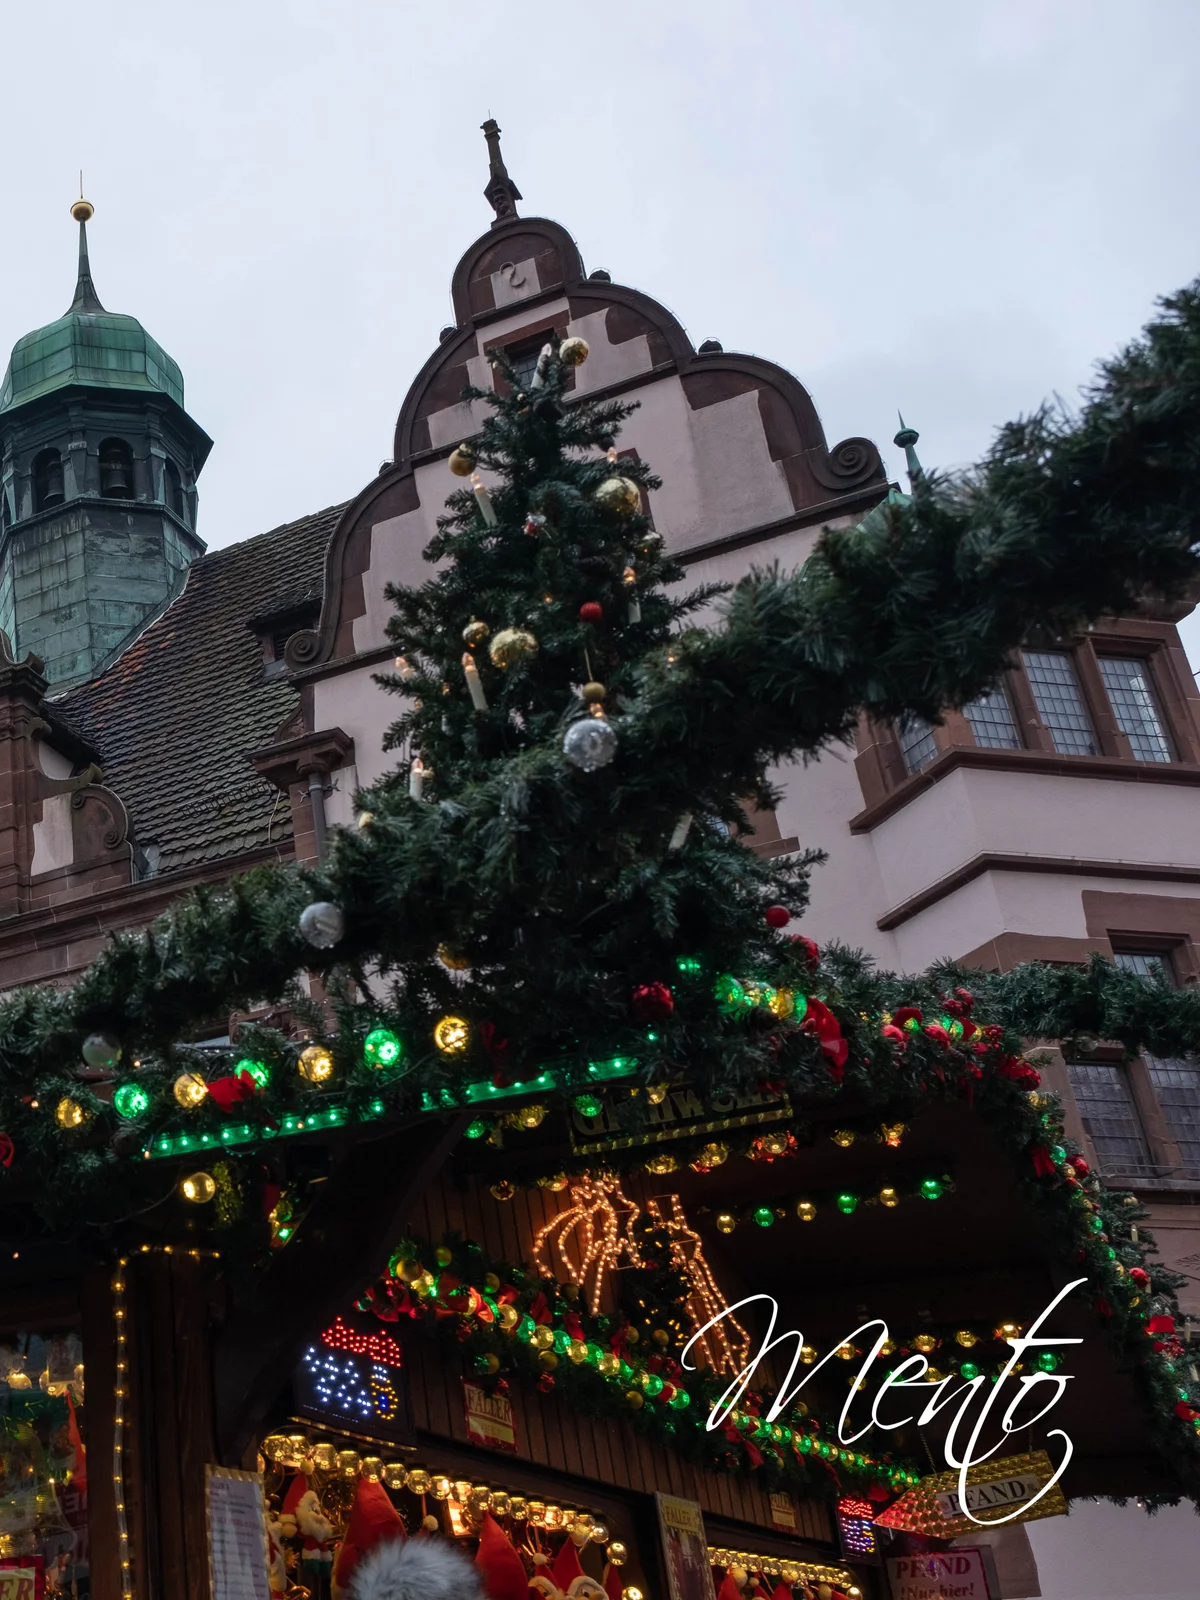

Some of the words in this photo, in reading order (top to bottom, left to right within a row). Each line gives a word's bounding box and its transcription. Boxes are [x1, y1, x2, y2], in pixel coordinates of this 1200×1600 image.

[946, 1480, 1026, 1511] PFAND
[896, 1556, 972, 1580] PFAND
[939, 1582, 975, 1598] hier!
